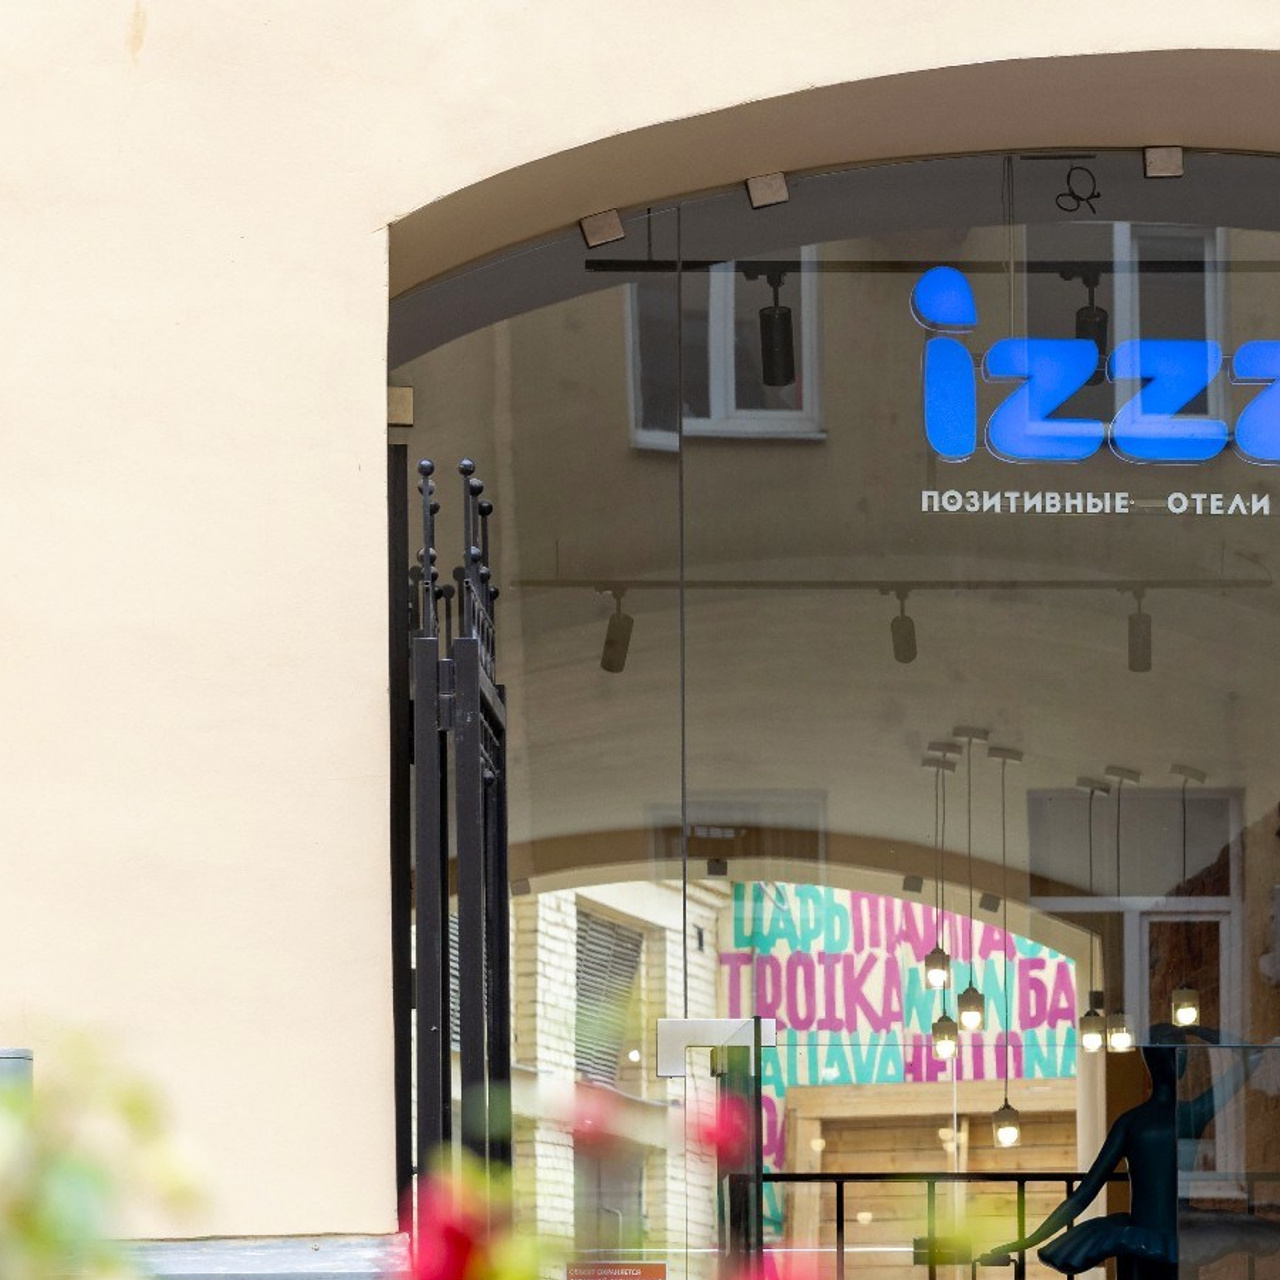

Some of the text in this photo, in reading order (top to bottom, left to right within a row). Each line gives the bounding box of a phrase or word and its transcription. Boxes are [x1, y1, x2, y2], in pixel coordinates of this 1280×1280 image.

[921, 490, 1271, 516] ПОЗИТИВНЫЕ ОТЕЛИ
[720, 951, 903, 1034] TROIKA
